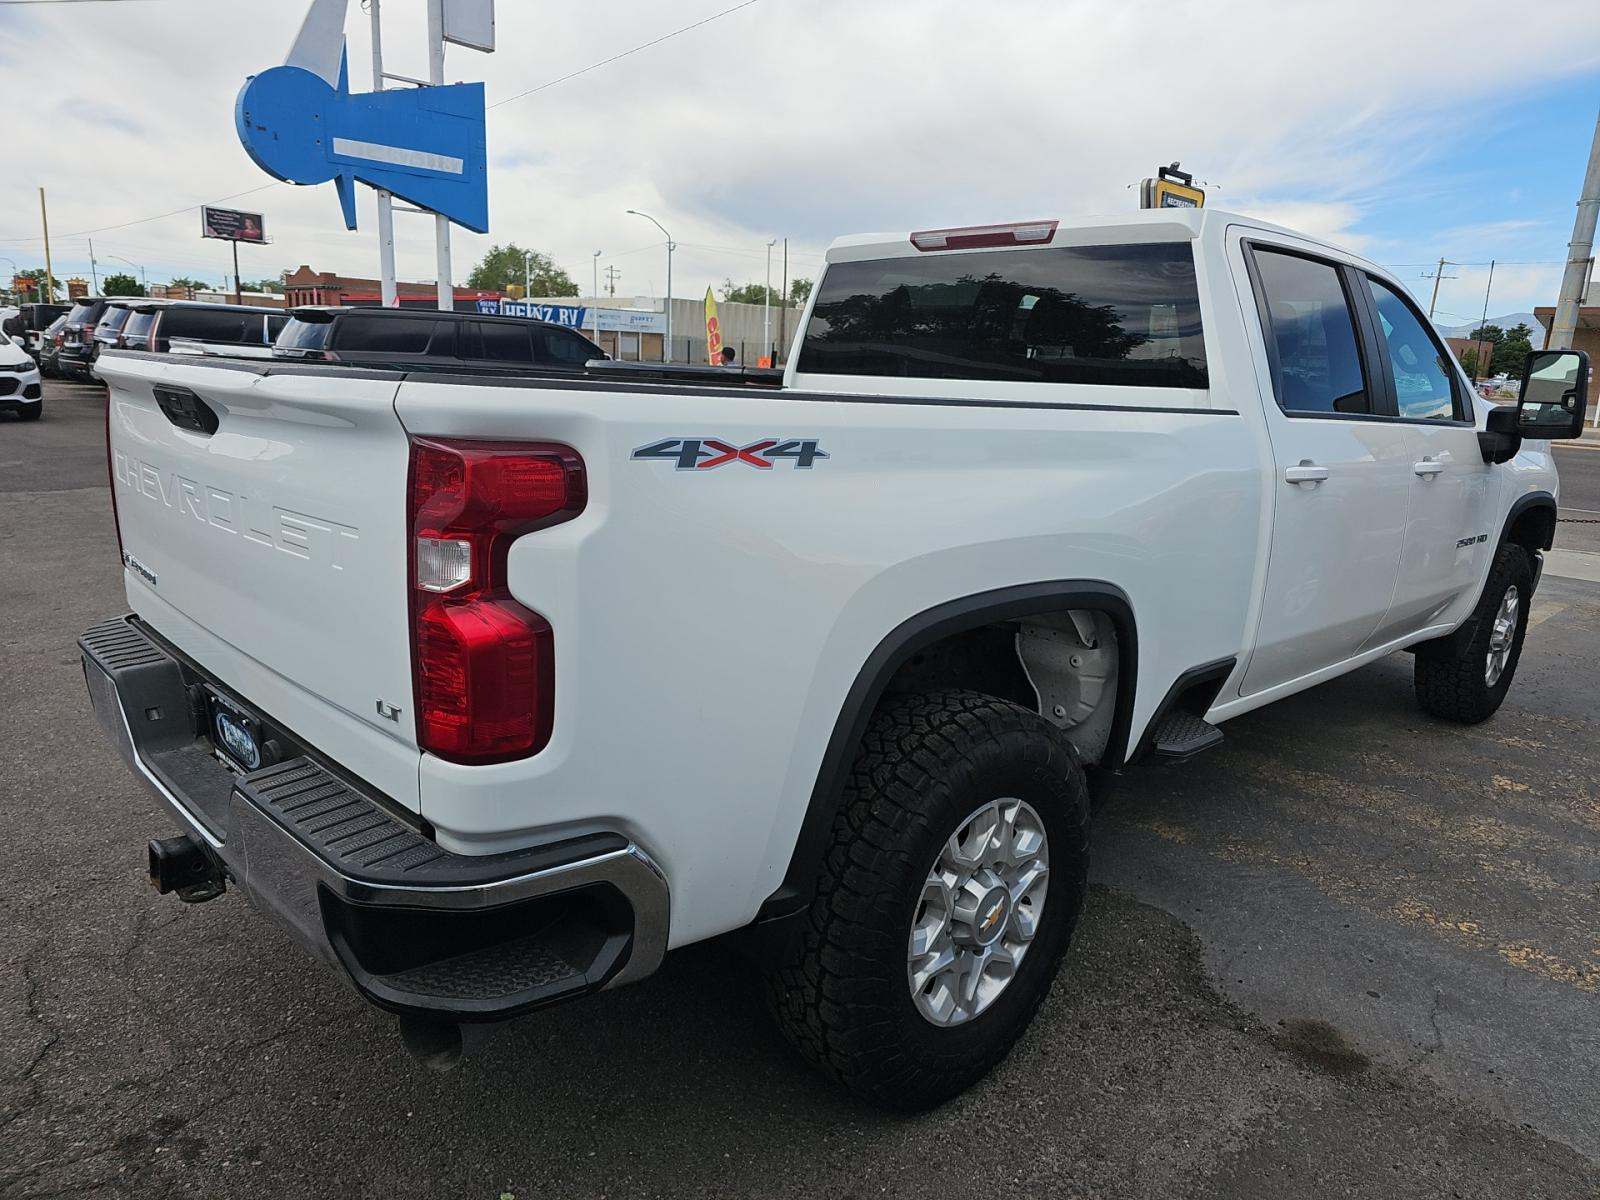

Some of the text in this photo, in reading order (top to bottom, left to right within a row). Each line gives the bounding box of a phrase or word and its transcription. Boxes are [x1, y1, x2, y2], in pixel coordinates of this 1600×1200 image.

[505, 304, 553, 323] HEINZ
[559, 308, 578, 325] RV
[114, 449, 359, 570] CHEVROLET
[375, 698, 402, 722] LT
